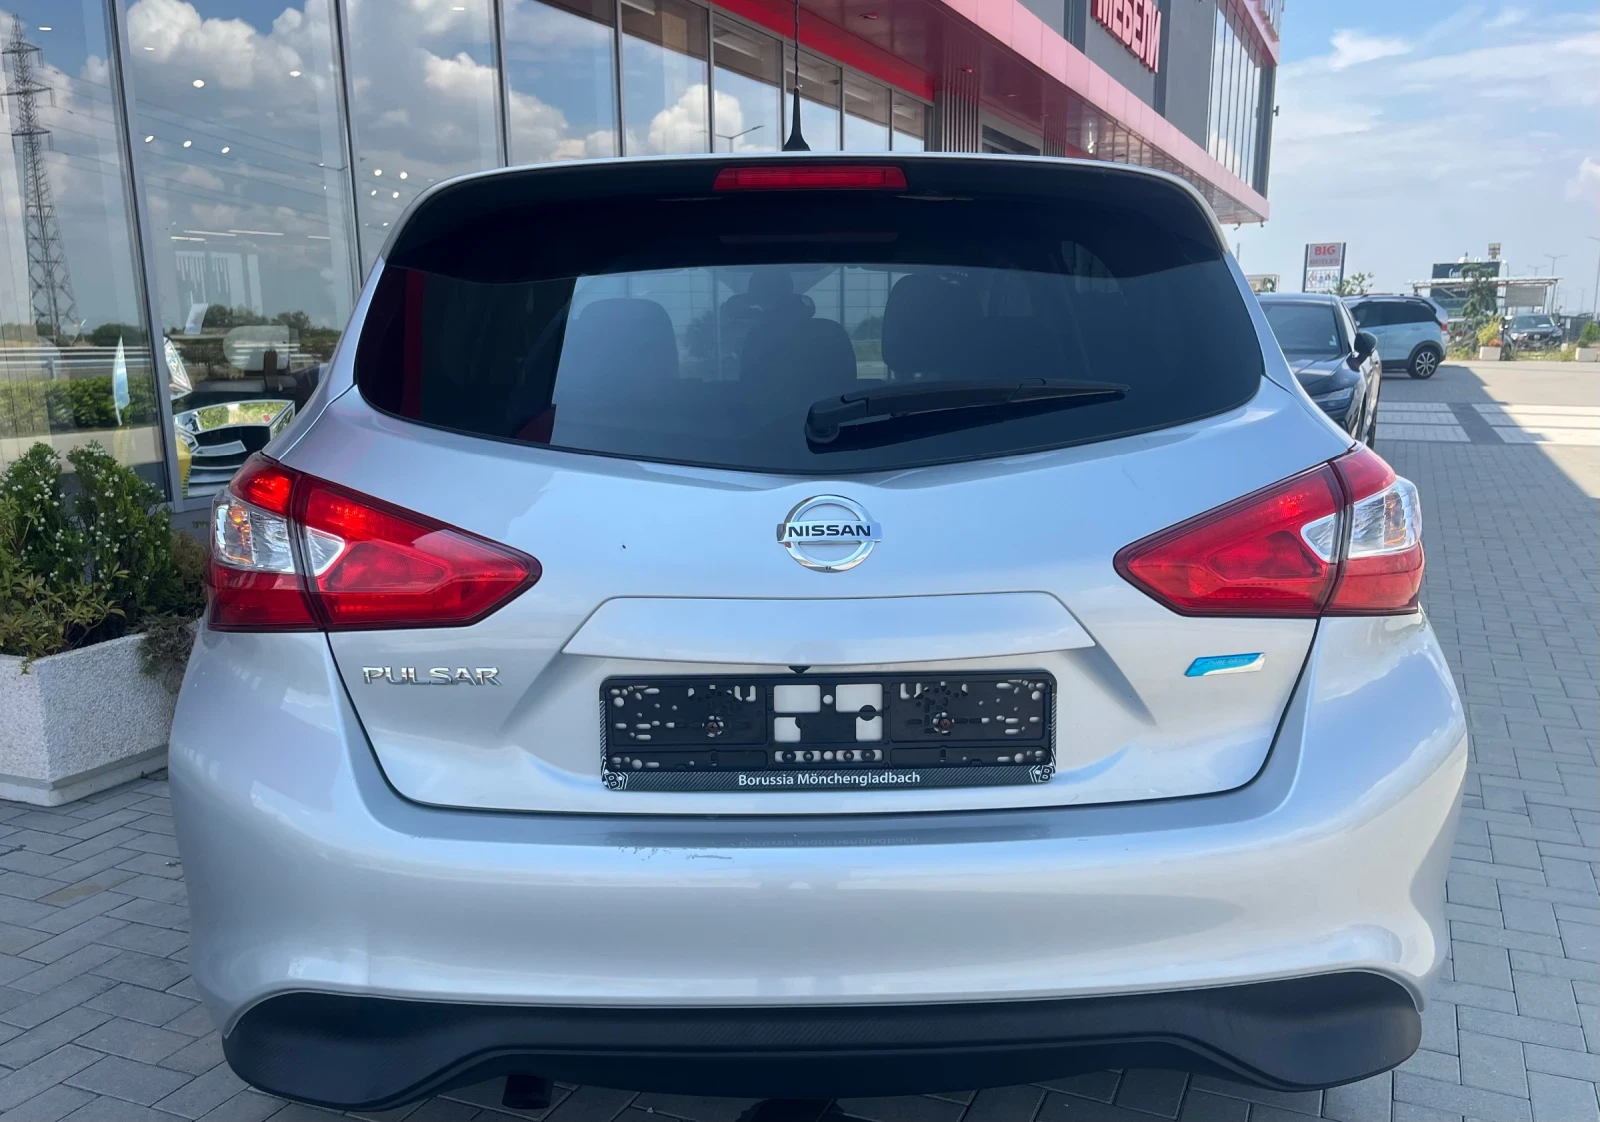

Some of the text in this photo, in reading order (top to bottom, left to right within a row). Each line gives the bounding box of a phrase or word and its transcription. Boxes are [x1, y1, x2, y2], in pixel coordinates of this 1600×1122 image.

[1314, 245, 1336, 256] BIG
[788, 524, 871, 538] NISSAN
[362, 666, 502, 686] PULSAR
[738, 772, 921, 786] Borussia Mönchengladbach
